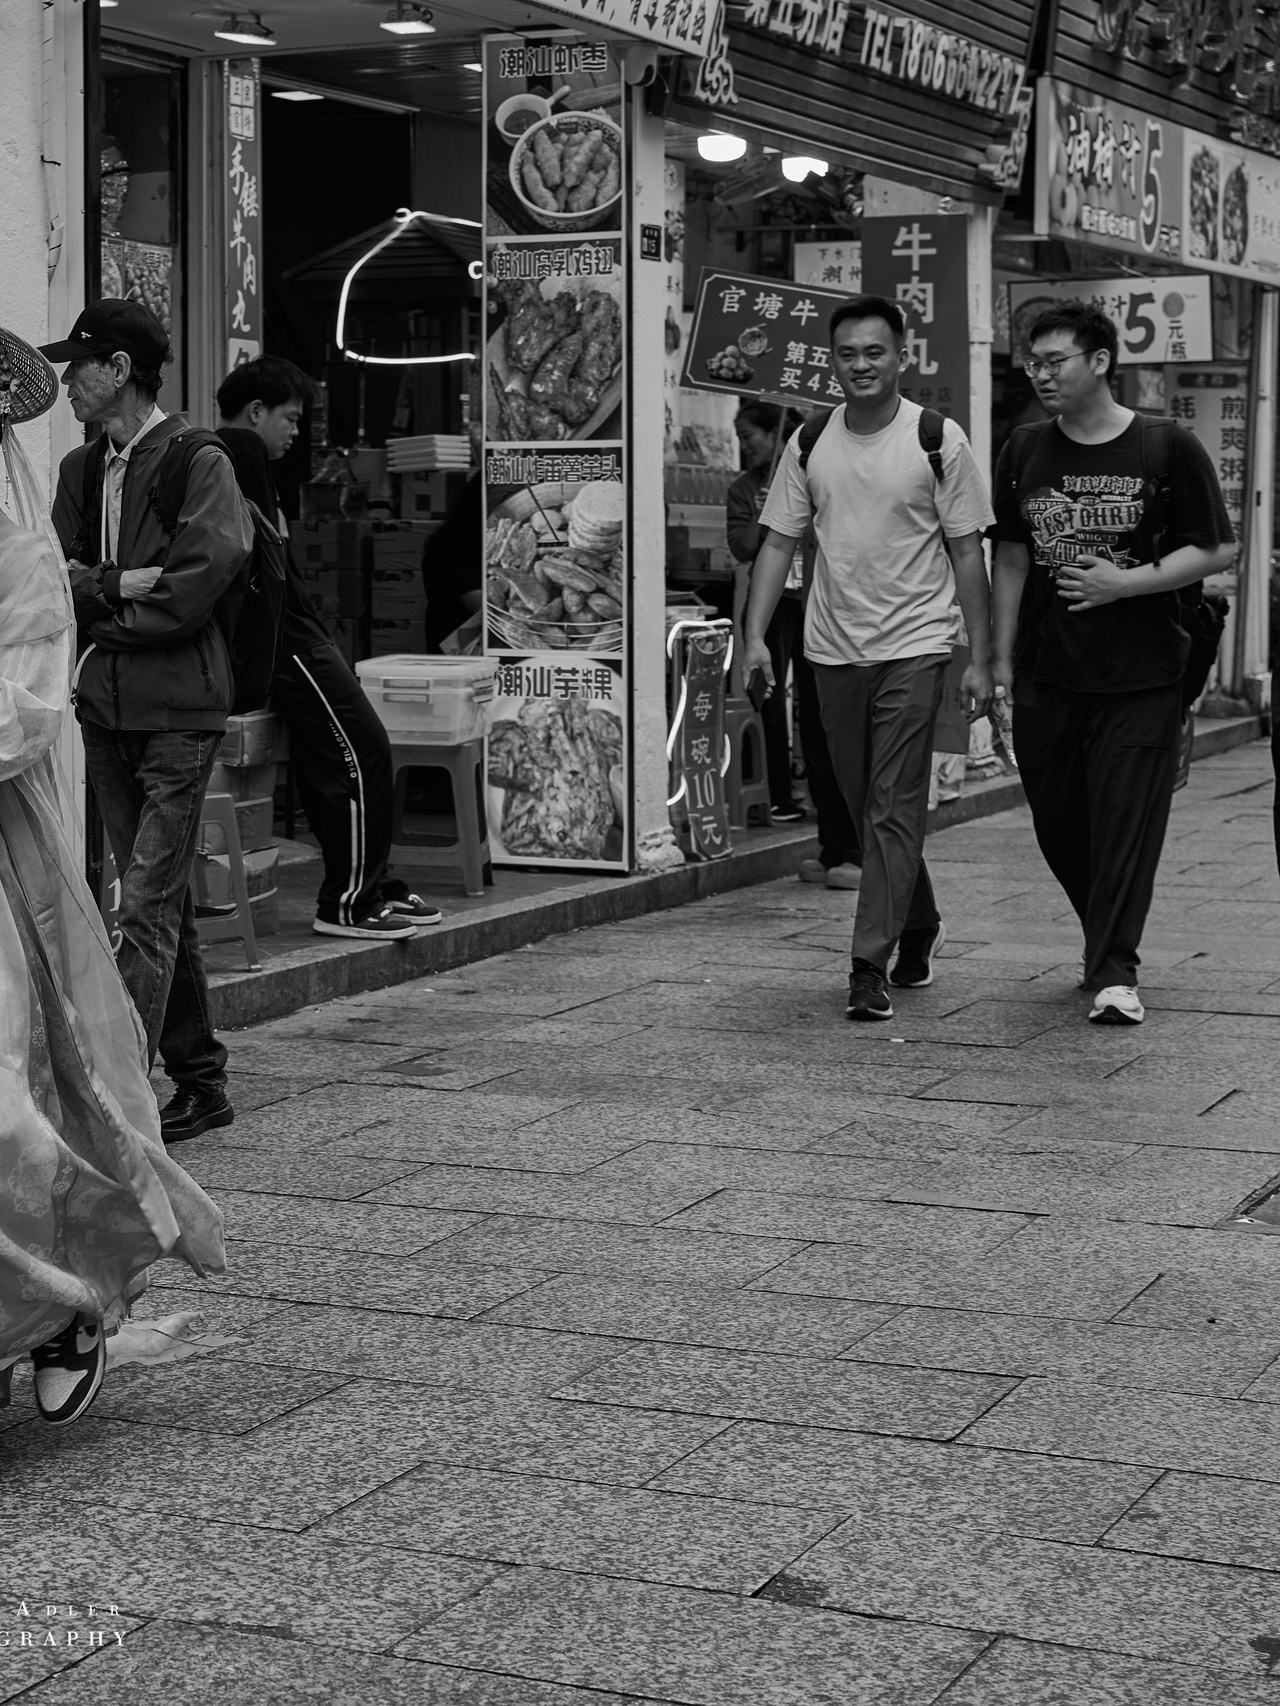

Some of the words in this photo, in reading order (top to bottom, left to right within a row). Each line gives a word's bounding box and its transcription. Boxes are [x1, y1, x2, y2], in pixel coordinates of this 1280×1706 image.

[860, 8, 894, 74] TEL
[1139, 118, 1163, 253] 5
[492, 247, 614, 279] 潮汕腐乳鸡翅
[719, 285, 818, 326] 官塘牛
[1124, 291, 1156, 354] 5
